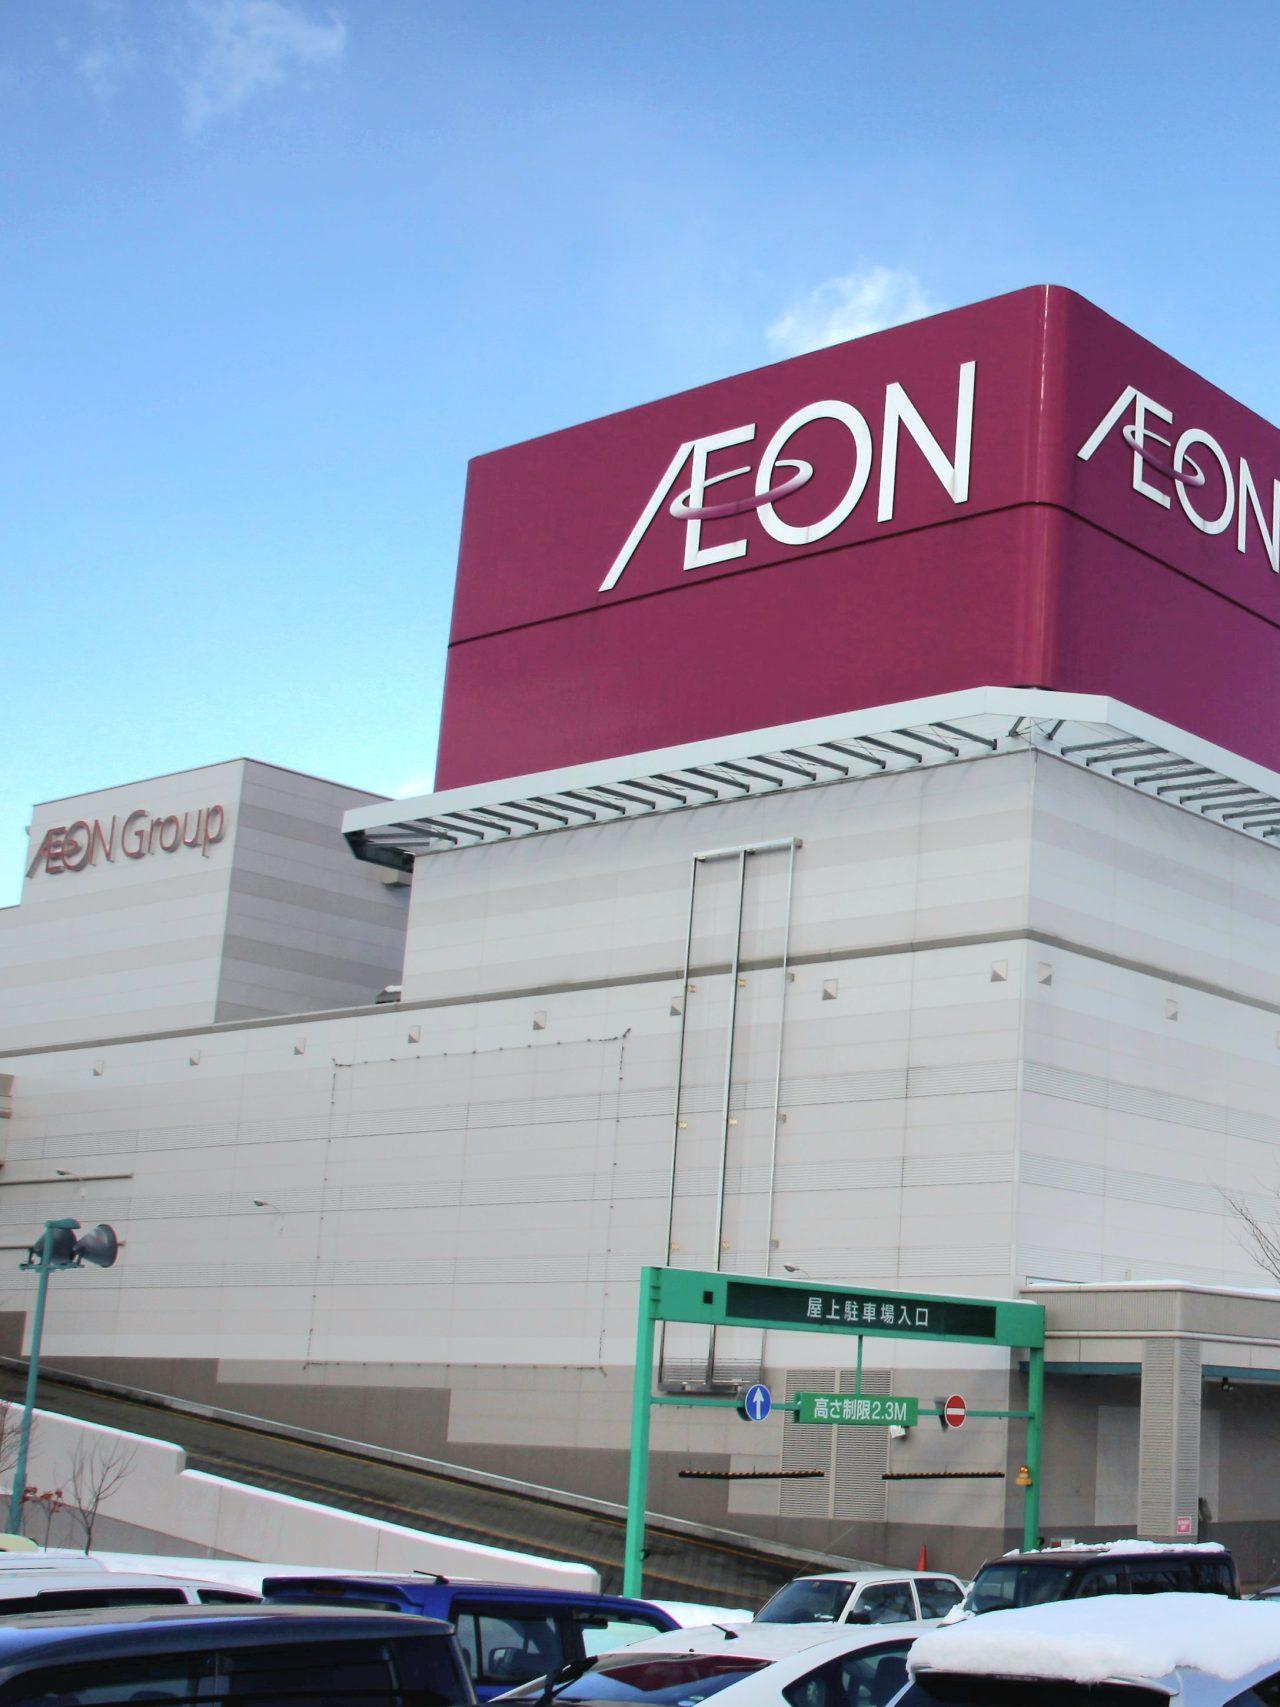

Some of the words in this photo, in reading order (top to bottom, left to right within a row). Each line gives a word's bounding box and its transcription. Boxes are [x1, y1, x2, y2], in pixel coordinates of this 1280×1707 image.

[121, 804, 225, 859] Group
[807, 1297, 929, 1326] 屋上駐車場入口
[813, 1397, 907, 1422] 高さ制限2.3M
